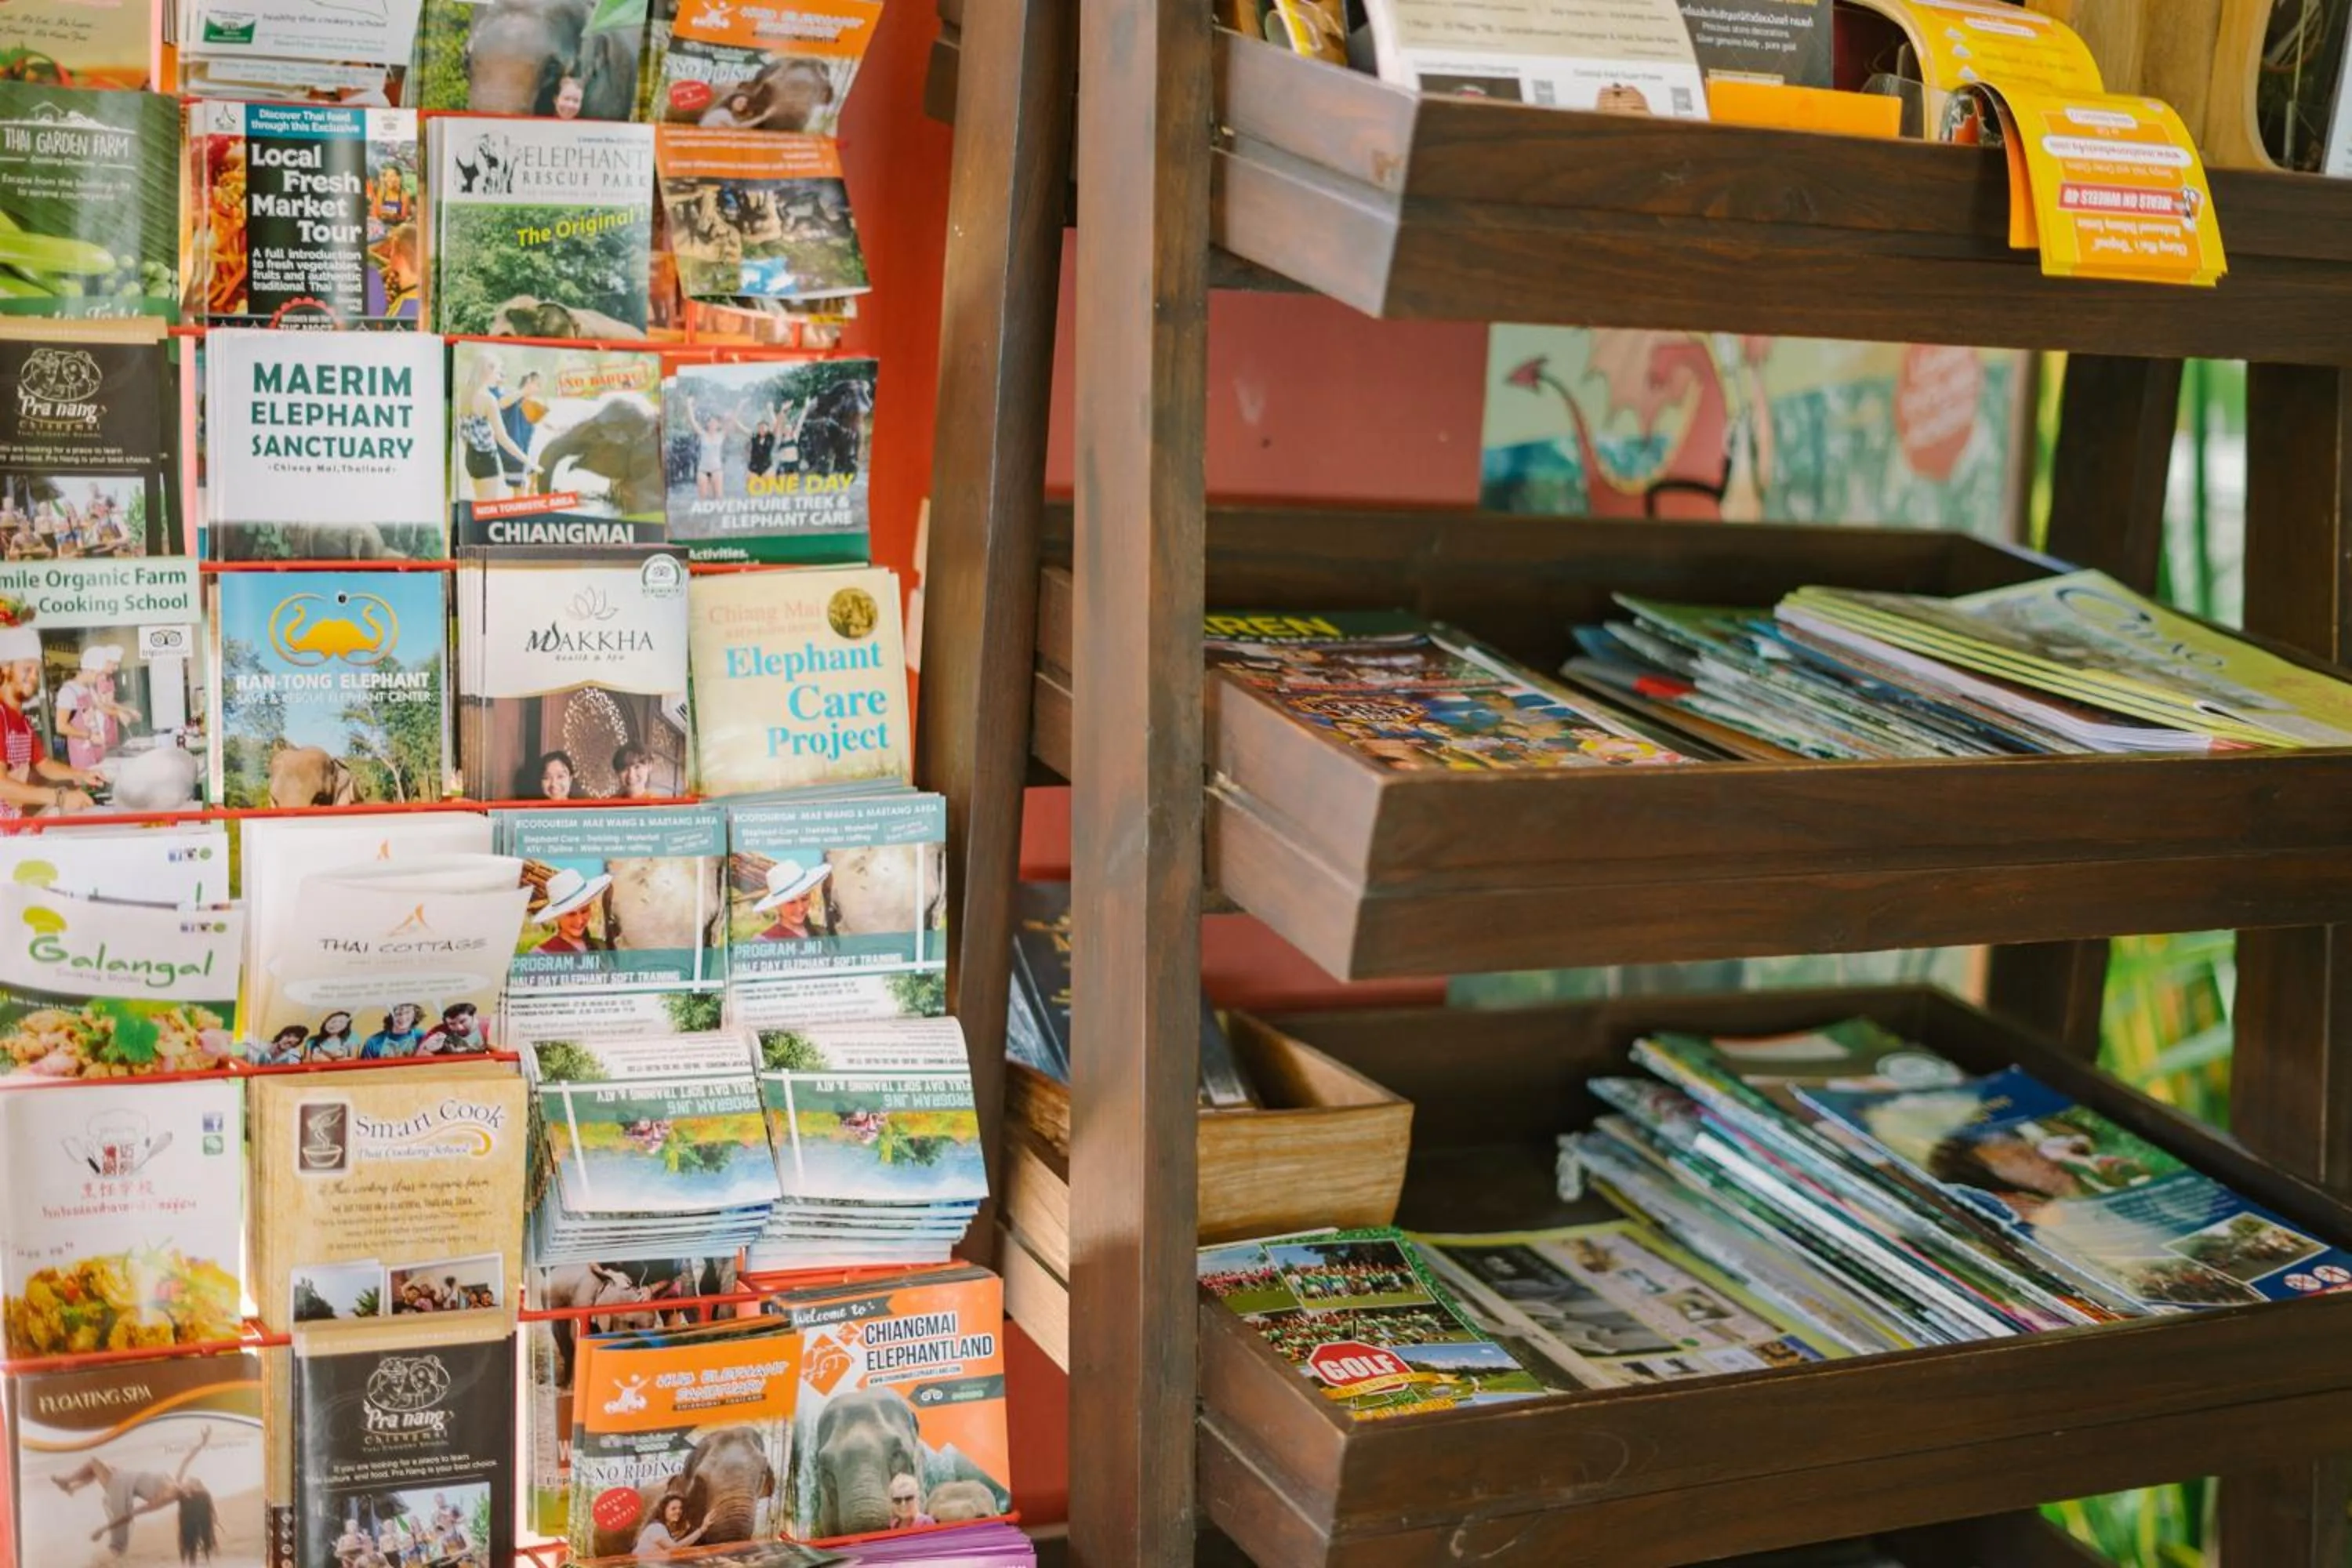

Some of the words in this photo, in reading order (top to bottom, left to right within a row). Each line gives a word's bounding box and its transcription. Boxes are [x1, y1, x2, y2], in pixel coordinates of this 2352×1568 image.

[260, 109, 301, 120] Discover
[304, 110, 325, 122] Thai
[251, 121, 289, 132] through
[292, 121, 310, 131] this
[312, 122, 360, 133] Exclusive
[4, 128, 31, 151] THAI
[36, 130, 89, 156] GARDEN
[93, 134, 129, 158] FARM
[251, 143, 322, 169] Local
[524, 146, 647, 169] ELEPHANT
[34, 175, 56, 185] from
[58, 176, 72, 187] the
[283, 170, 361, 194] Fresh
[523, 171, 590, 186] RESCUE
[603, 173, 647, 187] PARK
[252, 194, 348, 218] Market
[2080, 190, 2121, 208] WHEELS
[2123, 194, 2137, 209] ON
[2140, 194, 2172, 211] MEALS
[296, 220, 362, 243] Tour
[517, 227, 552, 247] The
[555, 207, 635, 238] Original
[252, 249, 261, 258] A
[265, 249, 285, 259] full
[288, 249, 361, 260] introduction
[252, 260, 263, 269] to
[266, 260, 294, 270] fresh
[252, 270, 281, 280] fruits
[283, 270, 305, 281] and
[308, 271, 361, 282] authentic
[252, 281, 305, 292] traditional
[310, 282, 332, 292] Thai
[337, 283, 361, 292] food
[253, 362, 412, 396] MAERIM
[20, 394, 50, 416] Pra
[56, 401, 97, 423] nang
[252, 401, 413, 427] ELEPHANT
[252, 434, 414, 459] SANCTUARY
[748, 474, 800, 495] ONE
[805, 473, 855, 493] DAY
[499, 500, 547, 514] TOURISTIC
[691, 497, 793, 514] ADVENTURE
[795, 495, 833, 510] TREK
[837, 495, 850, 508] &
[722, 513, 808, 529] ELEPHANT
[809, 510, 853, 525] CARE
[488, 521, 635, 544] CHIANGMAI
[0, 570, 39, 588] mile
[45, 568, 129, 591] Organic
[136, 568, 187, 585] Farm
[39, 594, 119, 615] Cooking
[125, 593, 188, 610] School
[709, 604, 778, 624] Chiang
[785, 601, 820, 617] Mai
[726, 641, 884, 682] Elephant
[340, 673, 430, 688] ELEPHANT
[389, 691, 431, 702] CENTER
[788, 684, 887, 721] Care
[768, 722, 890, 760] Project
[801, 811, 822, 821] MAE
[825, 810, 855, 819] WANG
[914, 804, 937, 814] AREA
[515, 818, 578, 829] ECOTOURISM
[583, 818, 604, 828] MAE
[608, 818, 637, 828] WANG
[695, 816, 718, 825] AREA
[319, 938, 368, 953] THAI
[379, 938, 488, 953] COTTAGE
[734, 942, 796, 956] PROGRAM
[29, 936, 213, 988] Galangal
[513, 956, 574, 972] PROGRAM
[734, 962, 759, 972] HALF
[762, 960, 782, 971] DAY
[783, 957, 831, 970] ELEPHANT
[833, 956, 858, 967] SOFT
[539, 975, 560, 985] DAY
[561, 972, 608, 985] ELEPHANT
[611, 972, 635, 983] SOFT
[638, 971, 681, 982] TRAINING
[709, 1084, 729, 1095] DAY
[816, 1081, 834, 1091] ATV
[848, 1080, 894, 1091] TRAINING
[897, 1080, 920, 1091] SOFT
[924, 1080, 945, 1091] DAY
[946, 1080, 971, 1091] FULL
[597, 1091, 615, 1102] ATV
[697, 1095, 757, 1112] PROGRAM
[912, 1094, 972, 1107] PROGRAM
[355, 1111, 432, 1138] Smart
[440, 1099, 505, 1129] Cook
[433, 1143, 469, 1155] School
[793, 1308, 847, 1324] Welcome
[866, 1313, 956, 1345] CHIANGMAI
[867, 1336, 993, 1371] ELEPHANTLAND
[1319, 1354, 1397, 1381] GOLF
[39, 1388, 120, 1413] FLOATING
[364, 1407, 397, 1429] Pra
[402, 1410, 445, 1430] nang
[341, 1465, 354, 1474] you
[370, 1461, 398, 1470] looking
[419, 1456, 440, 1465] place
[596, 1466, 619, 1481] NO
[625, 1462, 681, 1479] RIDING
